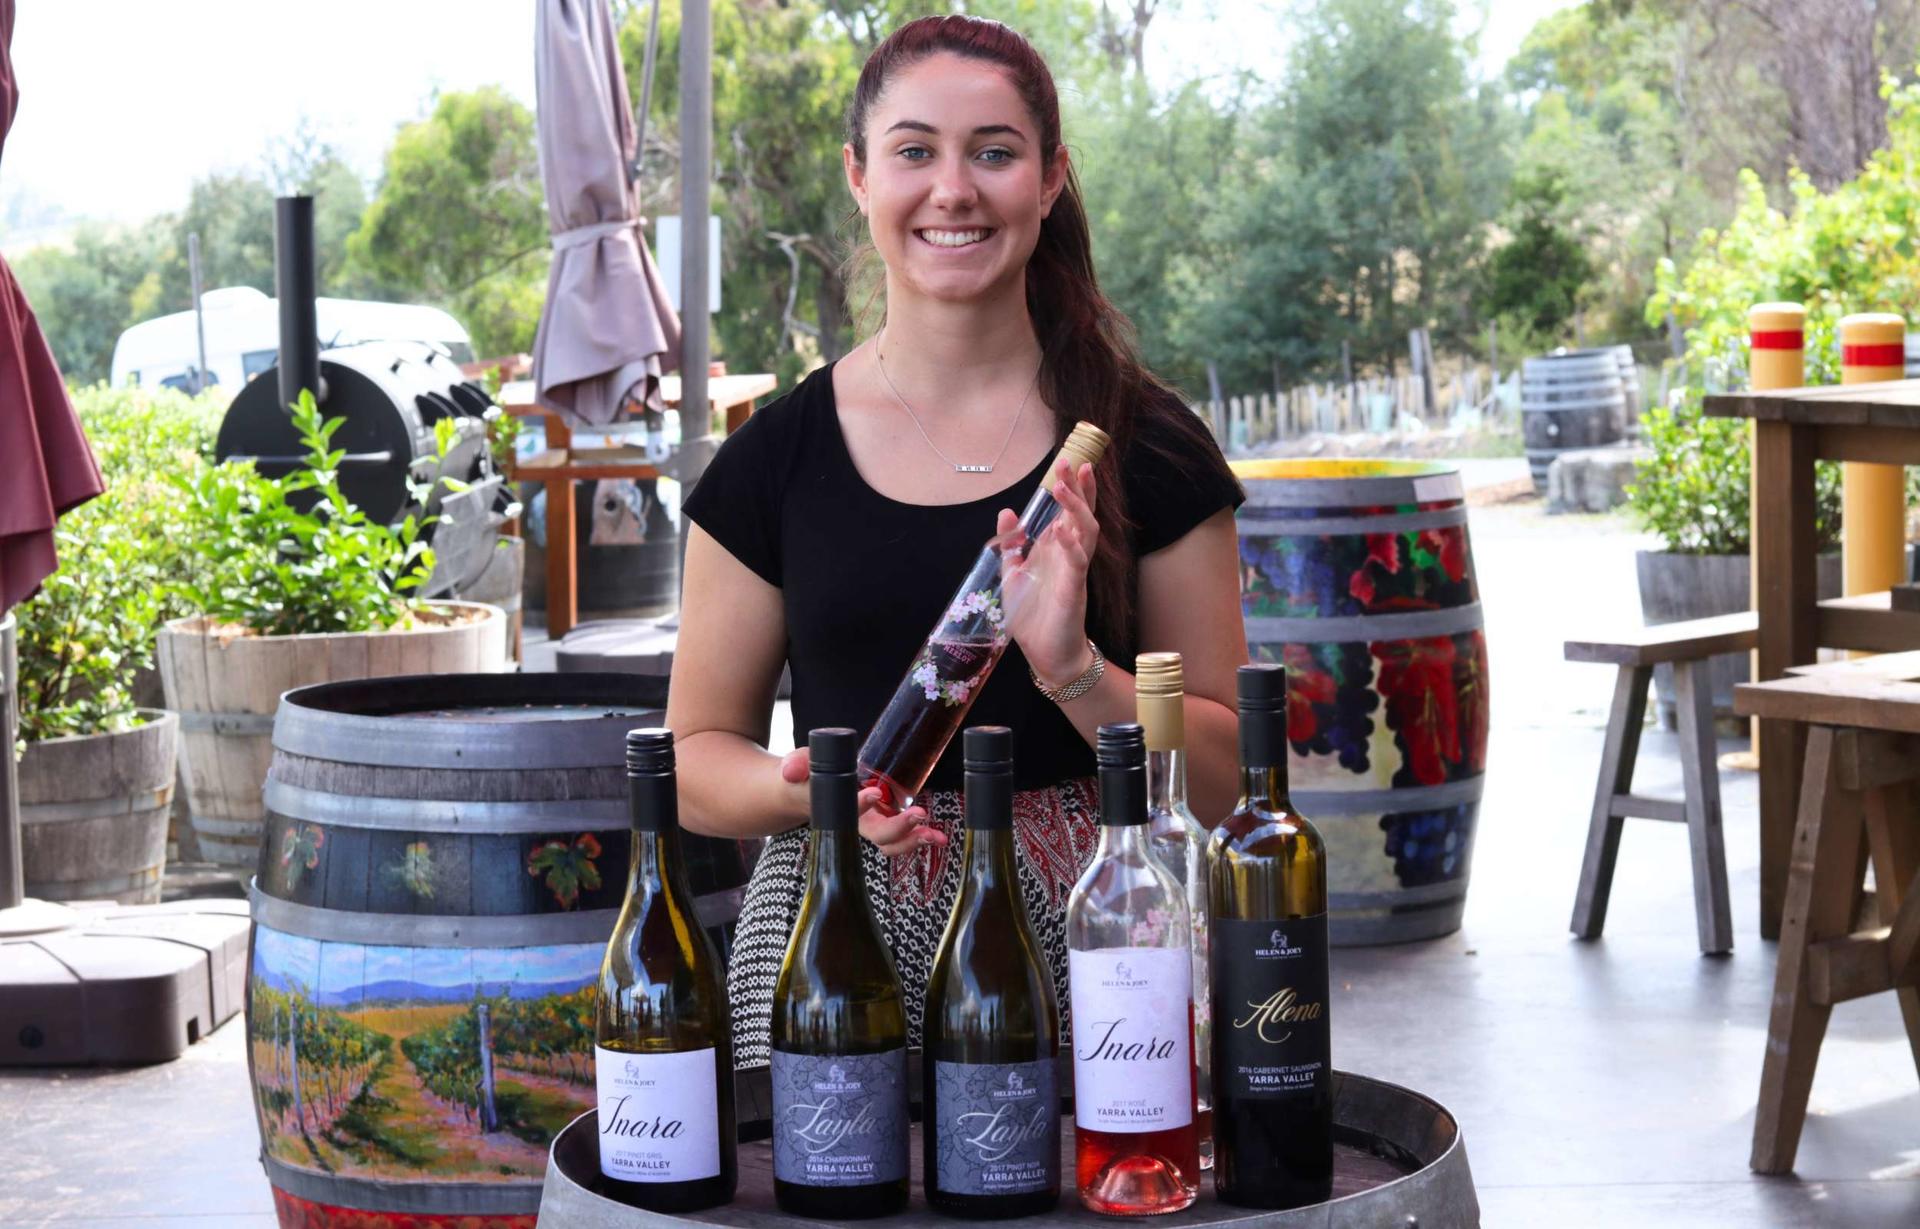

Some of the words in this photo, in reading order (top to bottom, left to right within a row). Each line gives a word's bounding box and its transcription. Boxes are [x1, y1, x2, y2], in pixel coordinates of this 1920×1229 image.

[1255, 948, 1280, 956] HELEN
[1286, 947, 1302, 956] JOEY
[1233, 987, 1322, 1044] Alena
[1078, 1018, 1177, 1061] Inara
[1290, 1062, 1322, 1072] SAUVIGNON
[1248, 1075, 1280, 1084] YARRA
[1282, 1072, 1314, 1083] VALLEY
[845, 1082, 862, 1090] JOEY
[602, 1095, 685, 1139] Inara
[1097, 1108, 1126, 1117] YARRA
[1129, 1106, 1164, 1116] VALLEY
[786, 1096, 876, 1153] Layla
[957, 1103, 1048, 1161] Layla
[612, 1158, 634, 1167] YARRA
[636, 1160, 670, 1169] VALLEY
[824, 1155, 871, 1163] CHARDONNAY
[806, 1164, 836, 1173] YARRA
[838, 1162, 874, 1173] VALLEY
[982, 1173, 1014, 1181] YARRA
[1016, 1168, 1046, 1180] VALLEY
